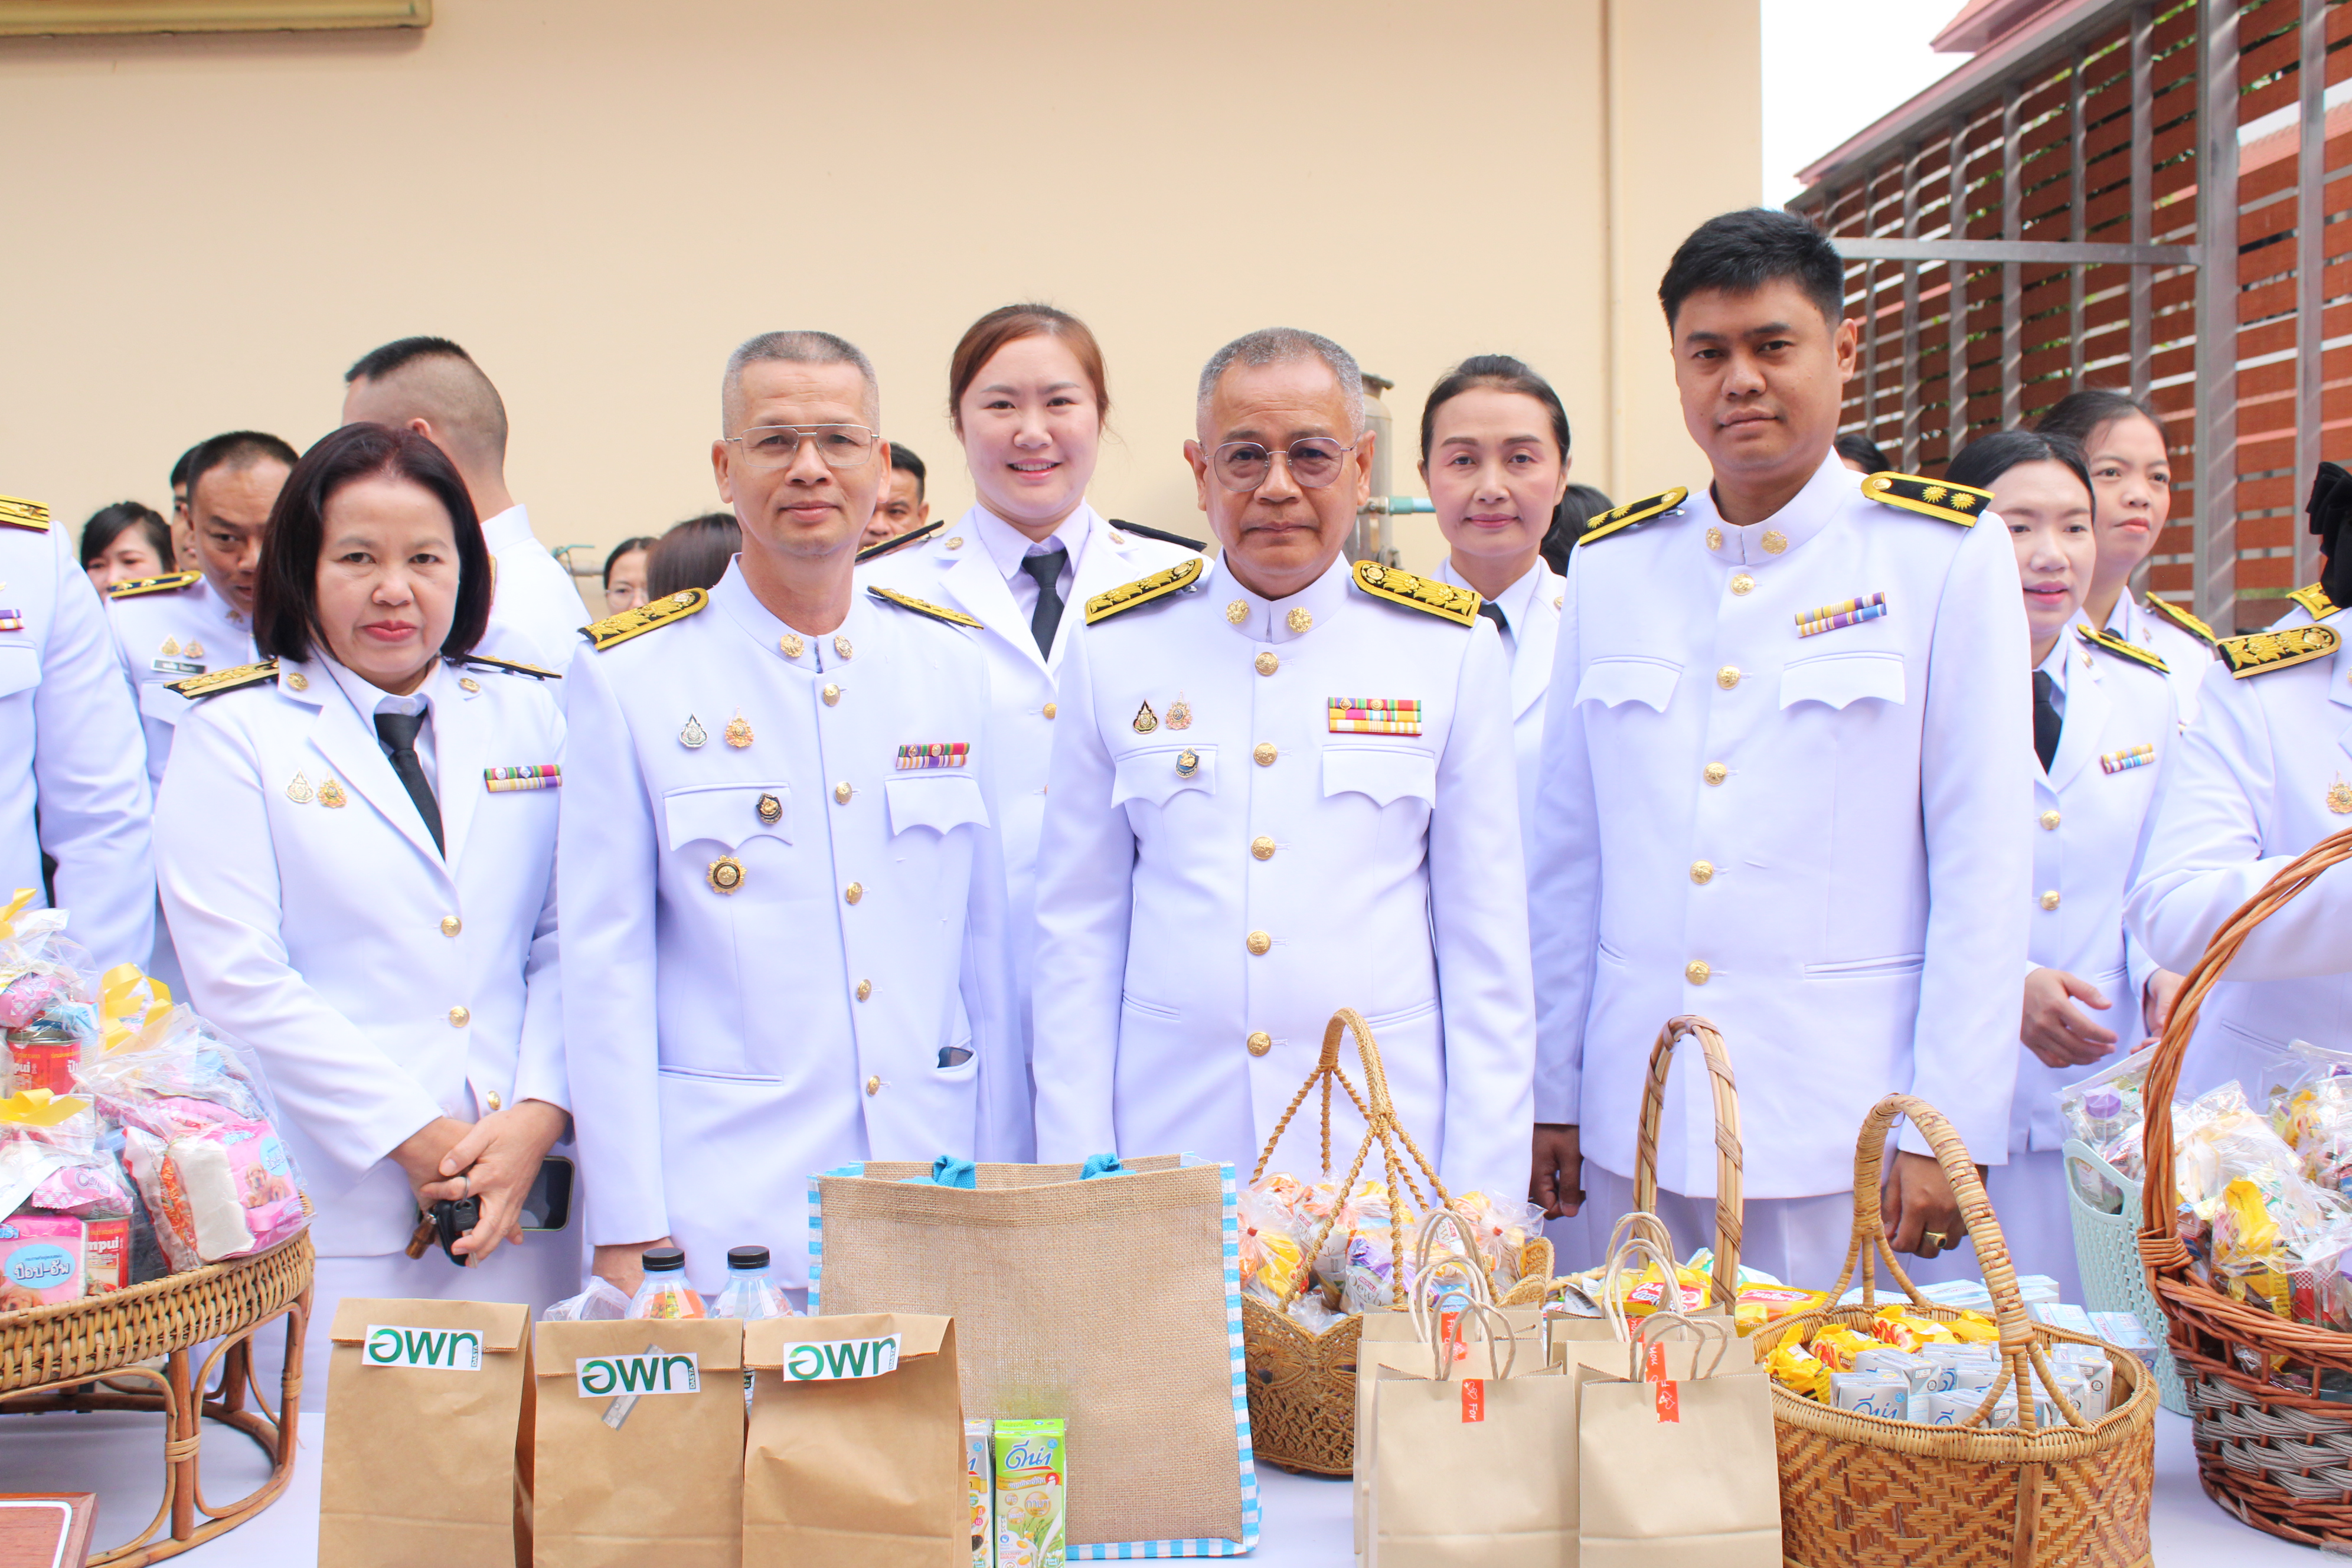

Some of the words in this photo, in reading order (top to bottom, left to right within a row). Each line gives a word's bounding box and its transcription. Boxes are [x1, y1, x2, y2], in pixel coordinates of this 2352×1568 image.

[14, 1260, 70, 1280] ป๊อป-อัพ
[1469, 1403, 1478, 1420] For
[1005, 1439, 1052, 1469] ดีน่า
[1026, 1500, 1050, 1508] กาบา
